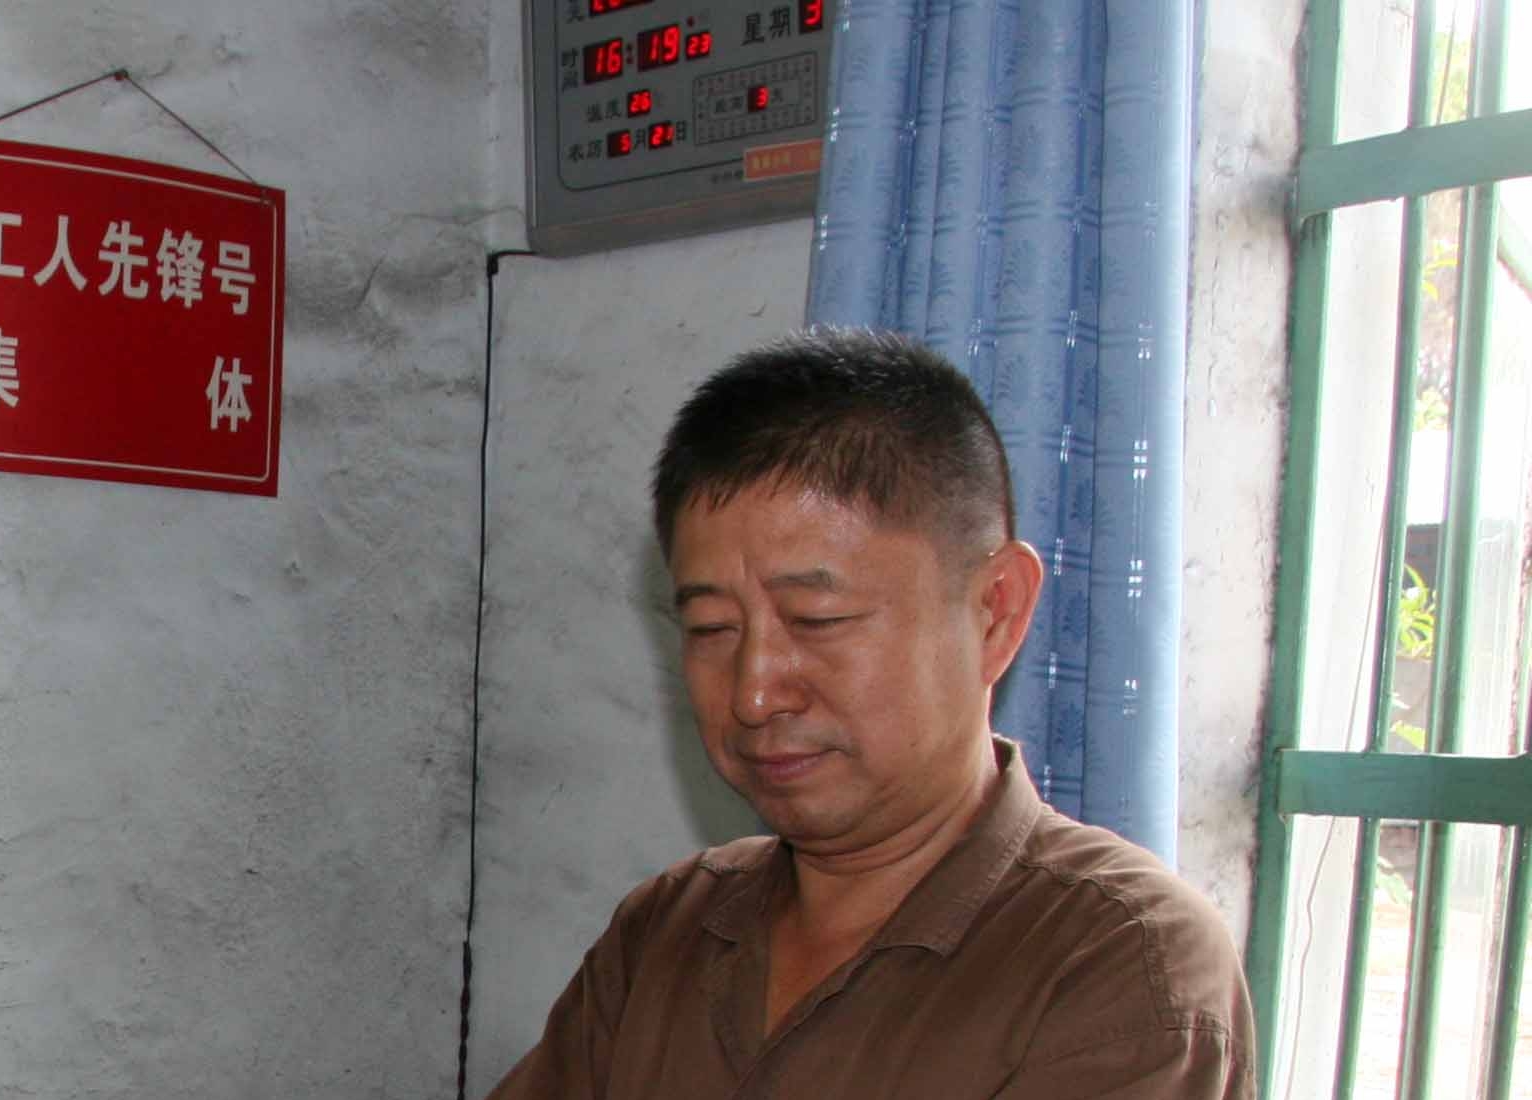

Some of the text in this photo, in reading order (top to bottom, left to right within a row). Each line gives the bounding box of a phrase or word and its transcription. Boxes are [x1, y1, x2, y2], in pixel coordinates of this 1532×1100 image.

[686, 32, 713, 57] 23
[742, 8, 792, 45] 星期
[205, 354, 253, 433] 体
